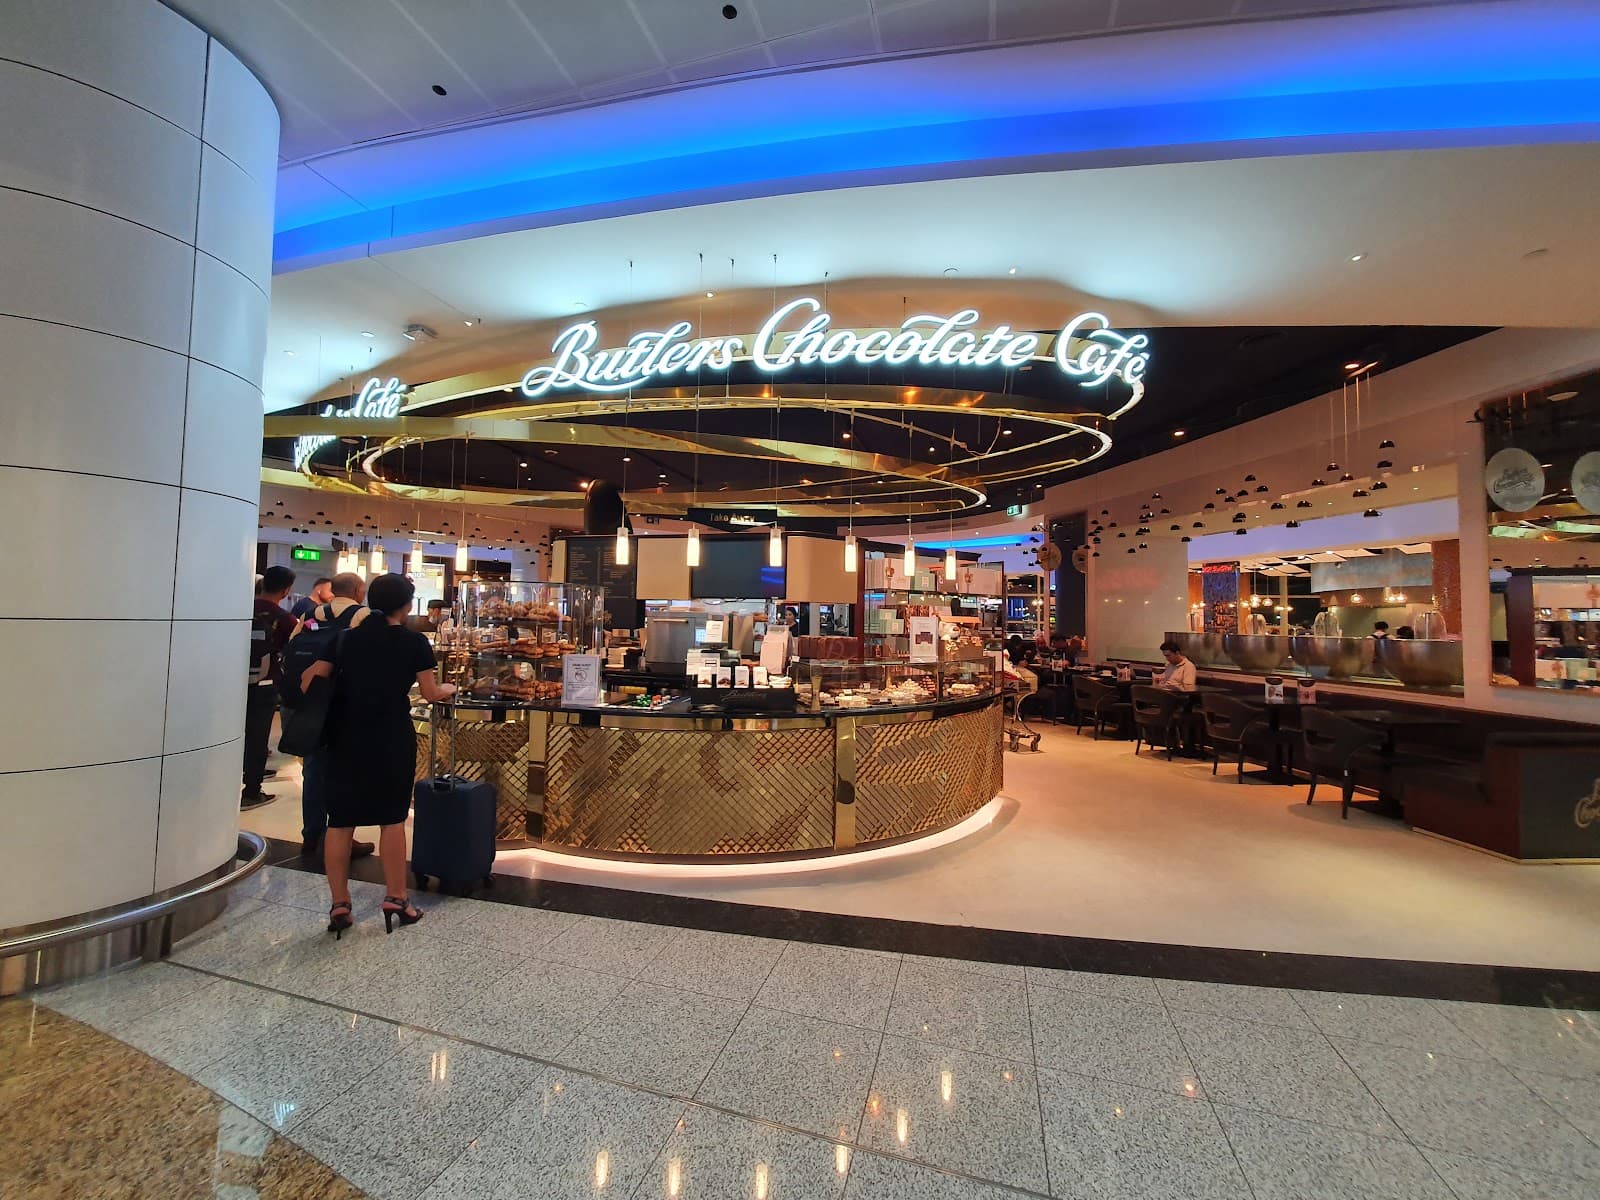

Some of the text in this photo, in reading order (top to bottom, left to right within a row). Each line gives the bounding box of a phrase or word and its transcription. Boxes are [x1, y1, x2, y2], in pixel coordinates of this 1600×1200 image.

[521, 297, 1150, 397] Butlers Chocolate Café
